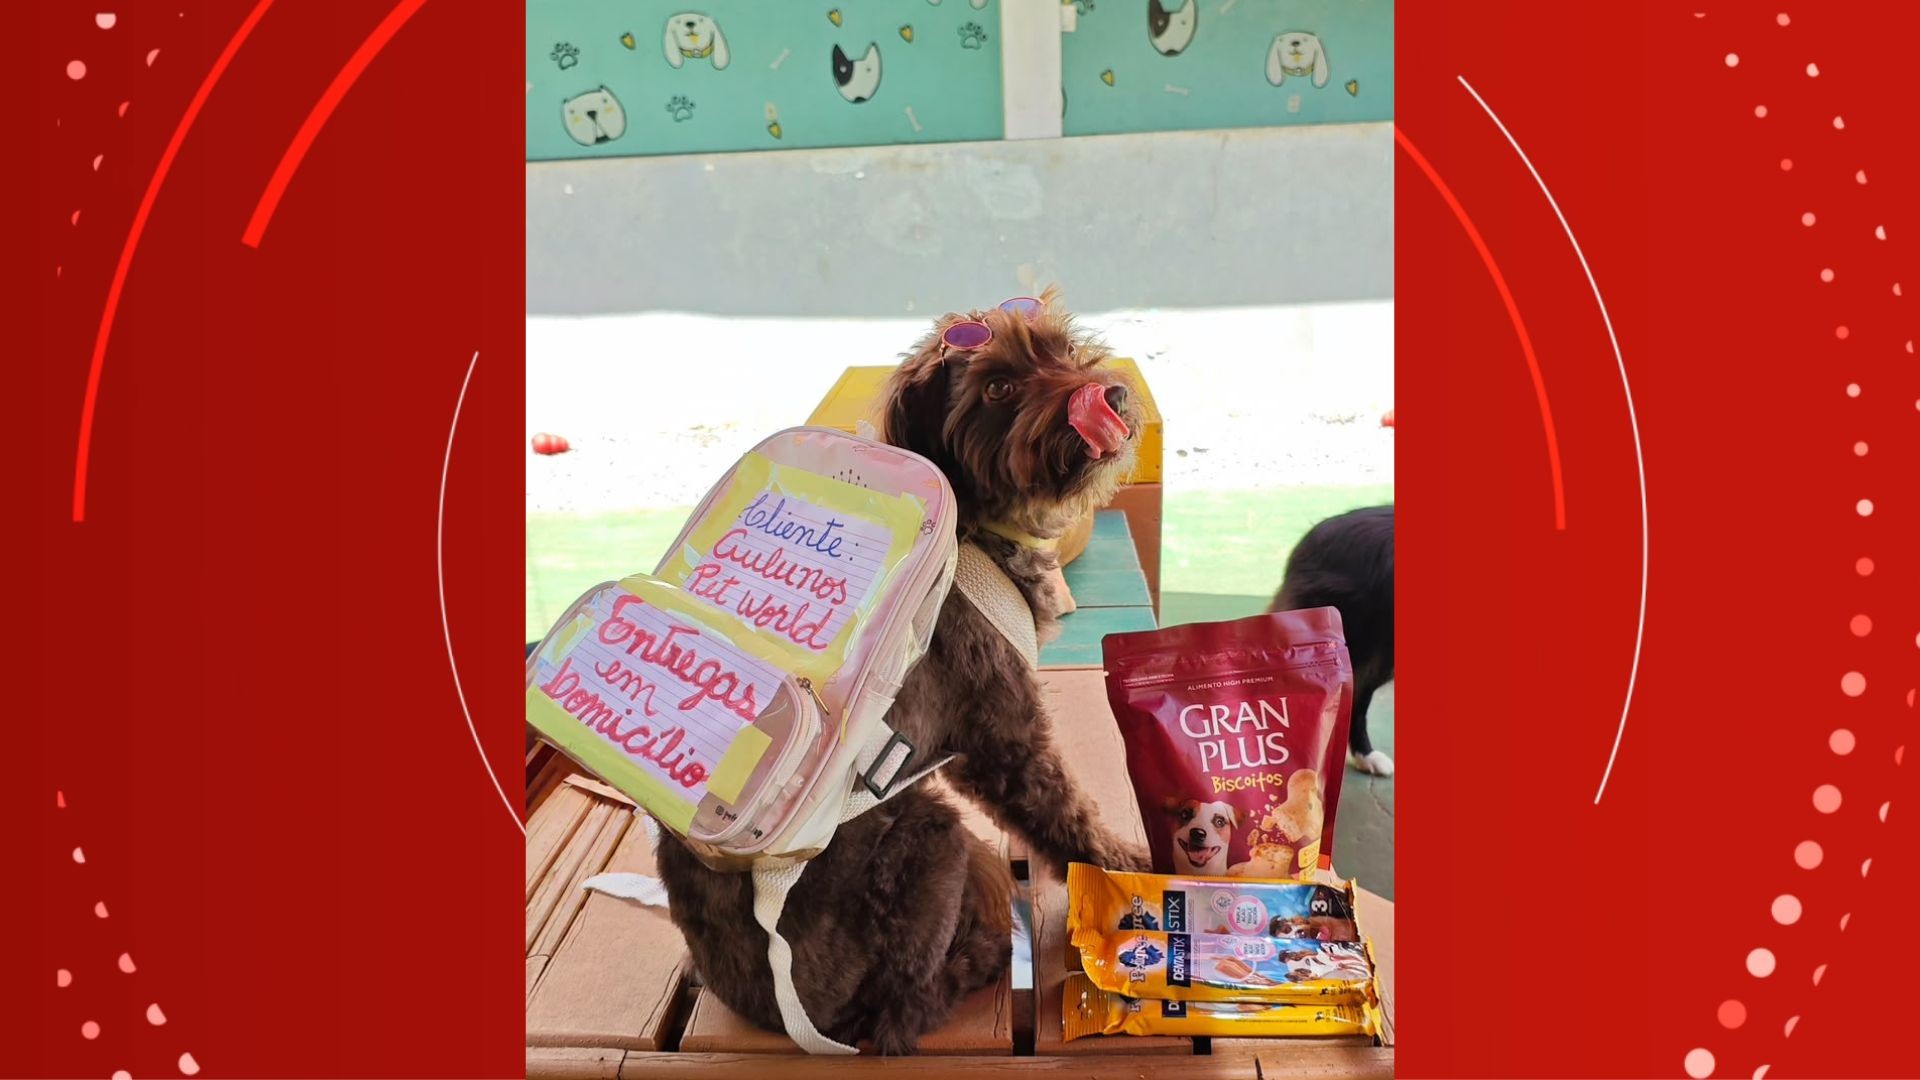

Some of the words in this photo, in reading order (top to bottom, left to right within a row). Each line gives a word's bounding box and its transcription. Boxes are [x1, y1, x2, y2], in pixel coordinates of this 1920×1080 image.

[742, 493, 859, 562] Cliente:
[736, 590, 834, 650] World
[598, 594, 758, 722] Entregas
[594, 660, 656, 717] em
[1187, 681, 1222, 691] ALIMENTO
[1223, 679, 1241, 687] HIGH
[1242, 676, 1274, 685] PREMIUM
[1179, 696, 1290, 738] GRAN
[1198, 732, 1290, 773] PLUS
[1211, 771, 1284, 794] Biscoitos
[1173, 937, 1186, 981] DENTASTIX
